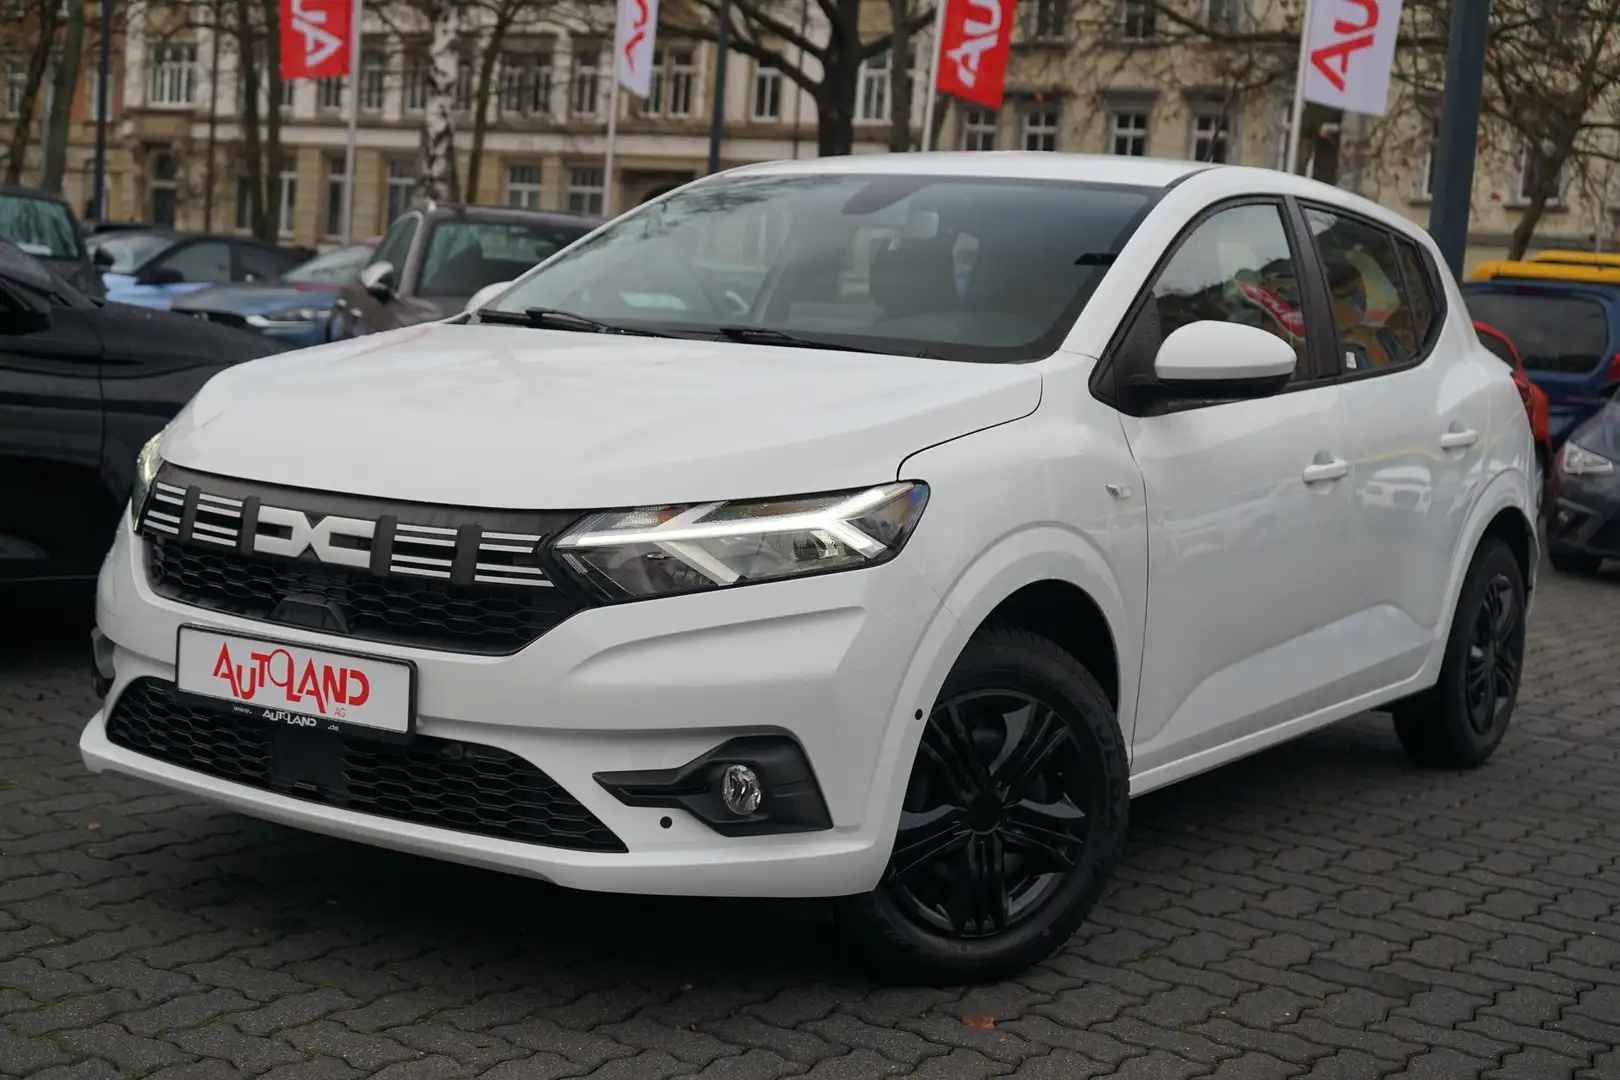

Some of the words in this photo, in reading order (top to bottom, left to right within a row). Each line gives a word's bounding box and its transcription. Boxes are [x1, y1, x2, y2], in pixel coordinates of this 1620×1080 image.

[946, 0, 1002, 88] AU
[1310, 0, 1379, 93] AU
[213, 641, 370, 714] AUTOLAND
[334, 707, 347, 718] AG
[262, 709, 317, 727] AUTOLAND
